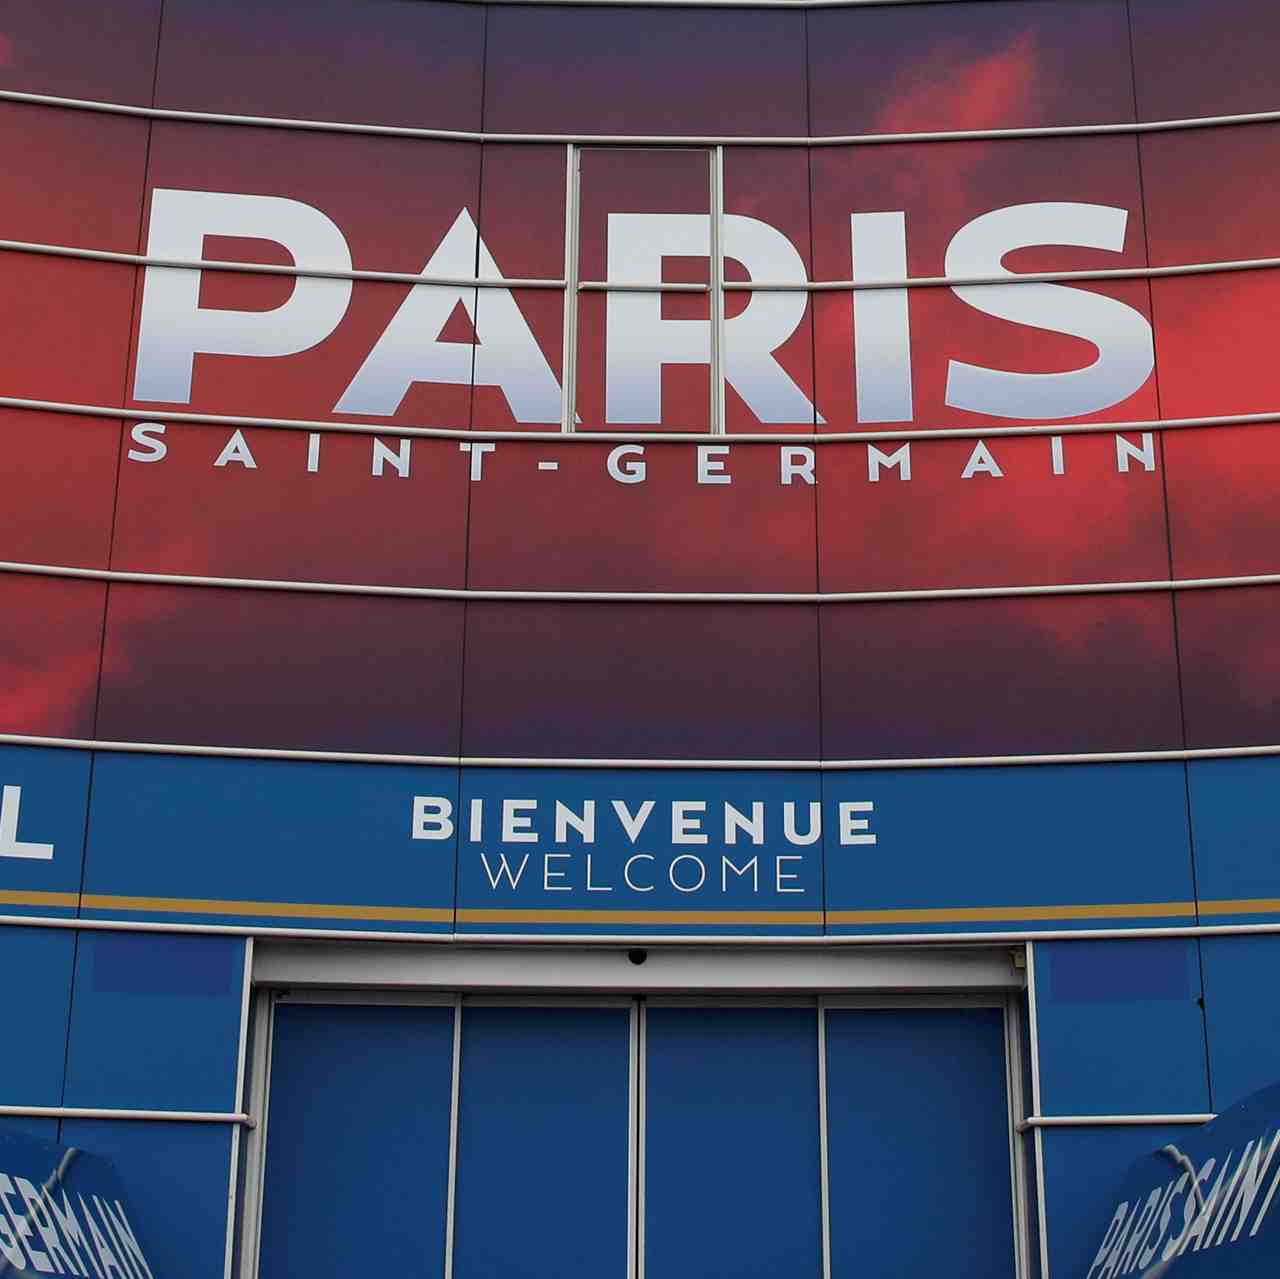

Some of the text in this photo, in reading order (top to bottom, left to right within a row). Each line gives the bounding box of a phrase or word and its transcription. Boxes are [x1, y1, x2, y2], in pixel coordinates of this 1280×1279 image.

[133, 187, 1155, 422] PARIS
[411, 796, 879, 847] BIENVENUE
[481, 853, 806, 894] WELCOME
